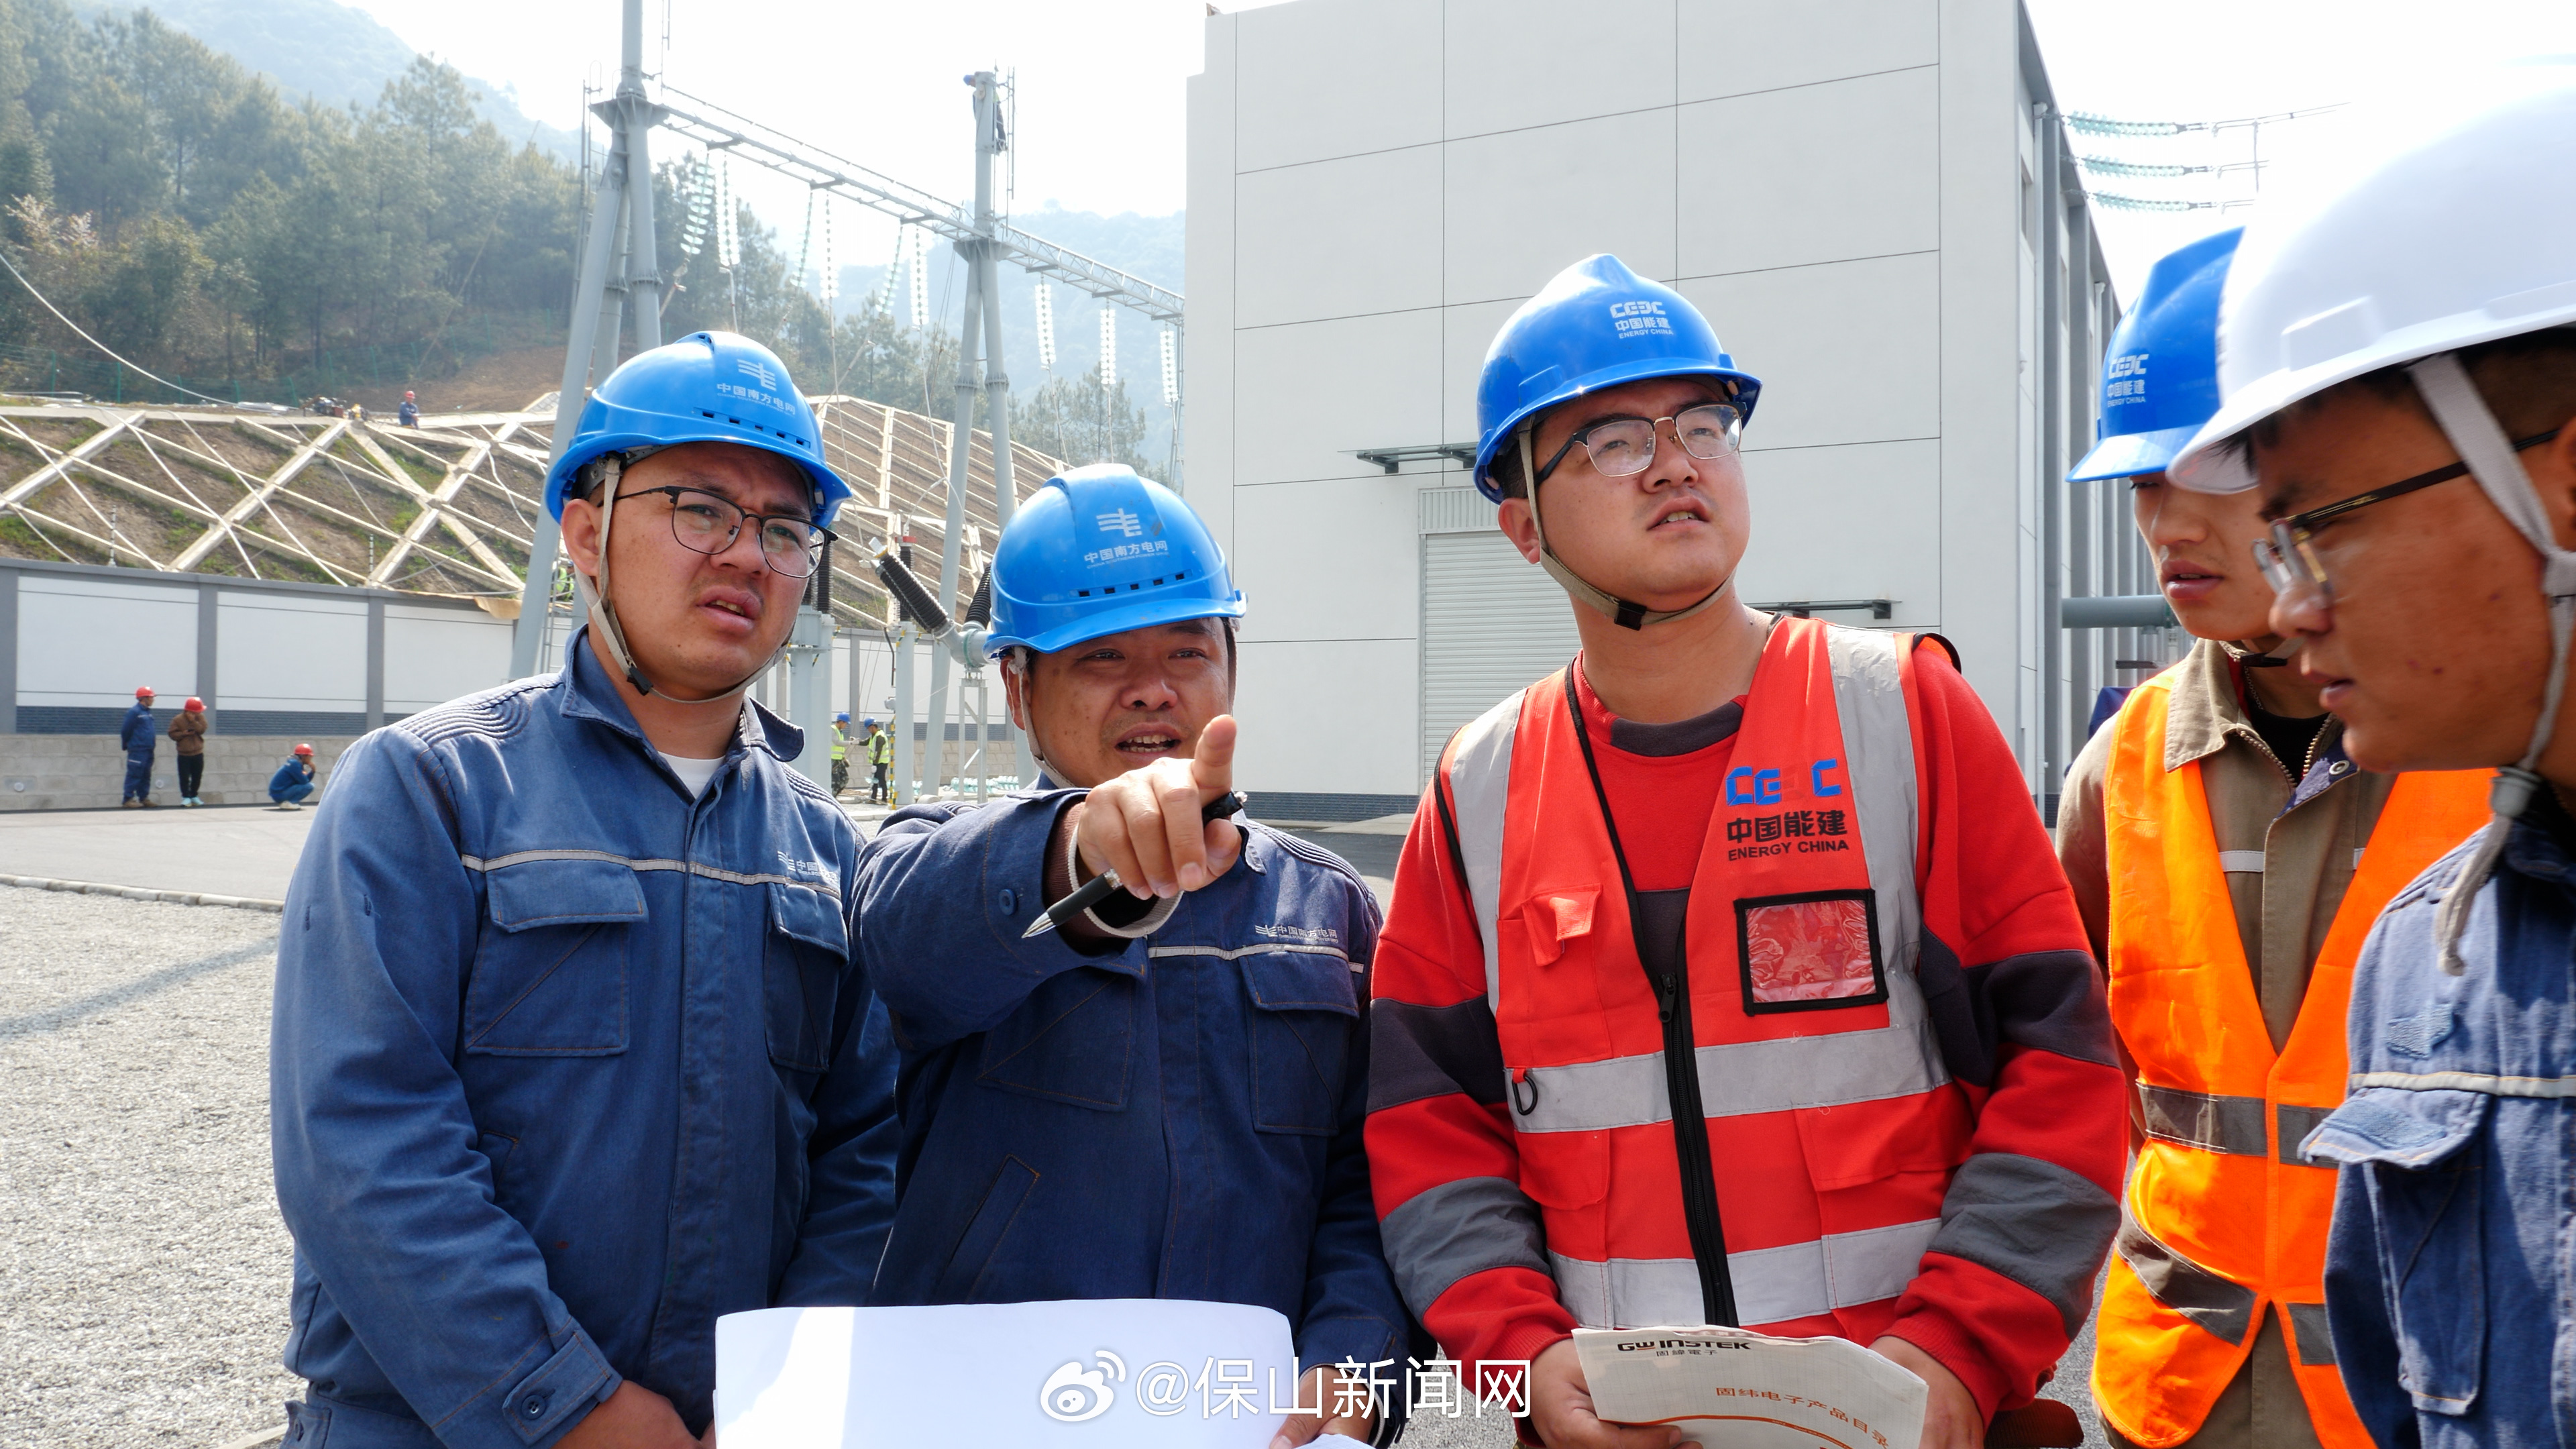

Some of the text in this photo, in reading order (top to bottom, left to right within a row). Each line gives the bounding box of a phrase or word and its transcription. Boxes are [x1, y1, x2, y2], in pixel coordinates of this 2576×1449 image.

[1615, 317, 1670, 331] 中国能建
[1619, 329, 1648, 339] ENERGY
[716, 383, 795, 415] 中国南方电网
[2108, 379, 2145, 398] 中国能建
[1084, 540, 1168, 563] 中国南方电网
[1727, 810, 1847, 843] 中国能建
[1728, 840, 1849, 861] ENERGY CHINA
[1716, 1387, 1889, 1449] 固纬电子产品目录
